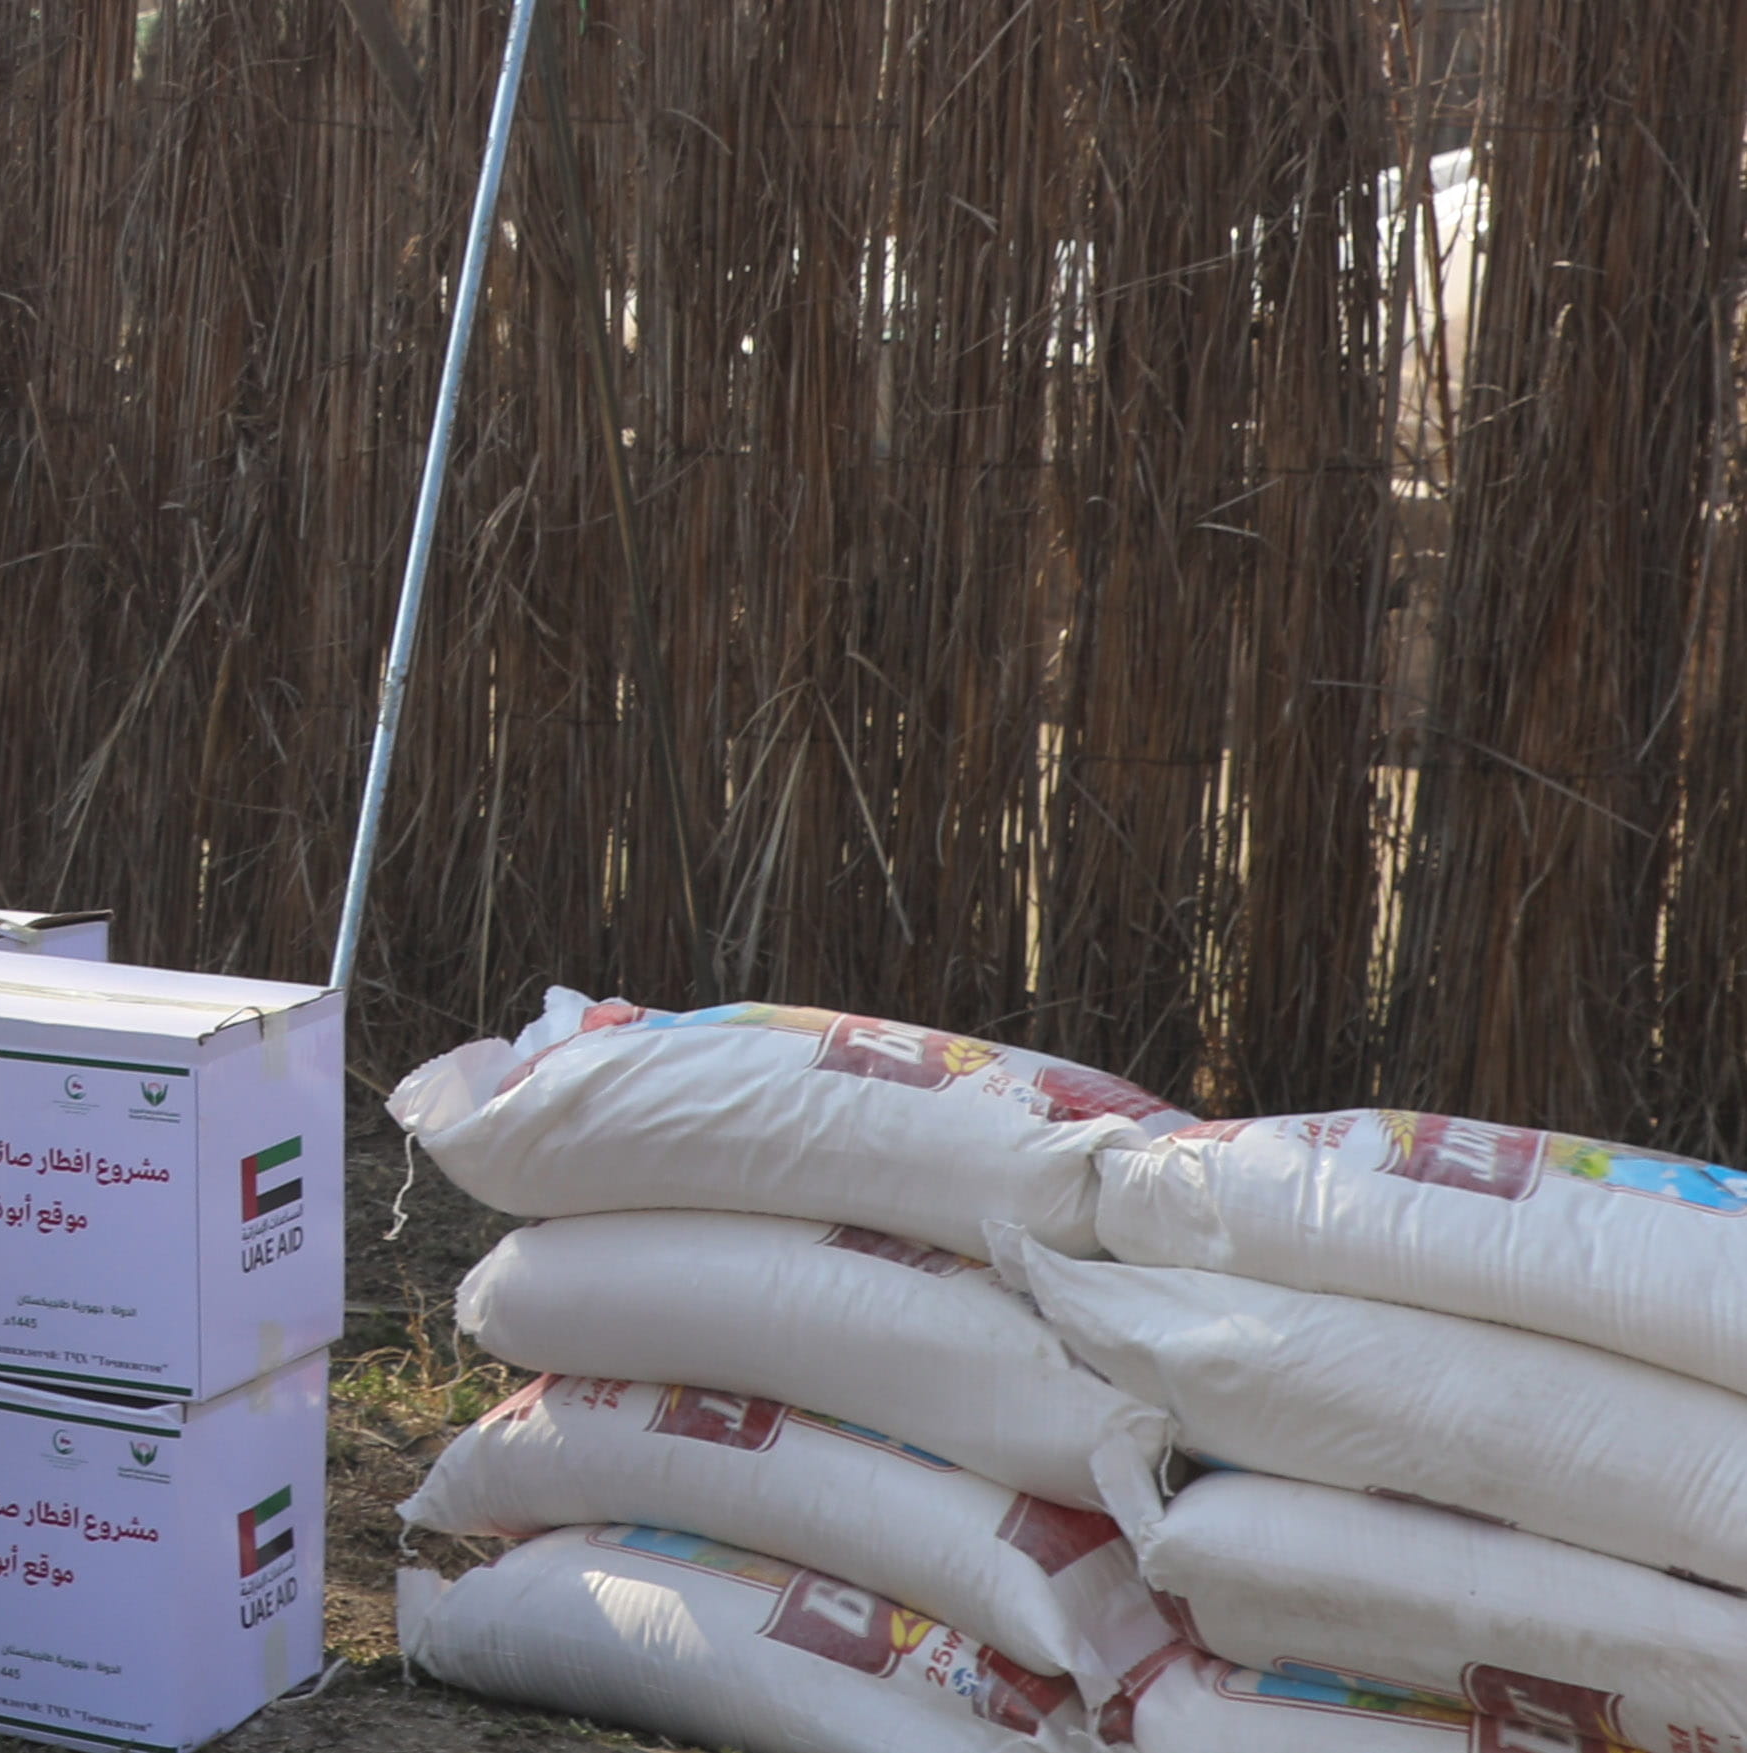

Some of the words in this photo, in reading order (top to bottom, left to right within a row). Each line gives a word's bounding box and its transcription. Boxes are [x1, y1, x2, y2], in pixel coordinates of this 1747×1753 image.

[37, 1149, 90, 1175] افطار
[97, 1158, 169, 1185] مشروع
[37, 1201, 87, 1233] موقع
[242, 1233, 273, 1273] UAE
[277, 1227, 303, 1258] AID
[25, 1501, 78, 1527] افطار
[85, 1515, 158, 1542] مشروع
[23, 1554, 73, 1587] موقع
[241, 1589, 274, 1629] UAE
[276, 1577, 297, 1611] AID
